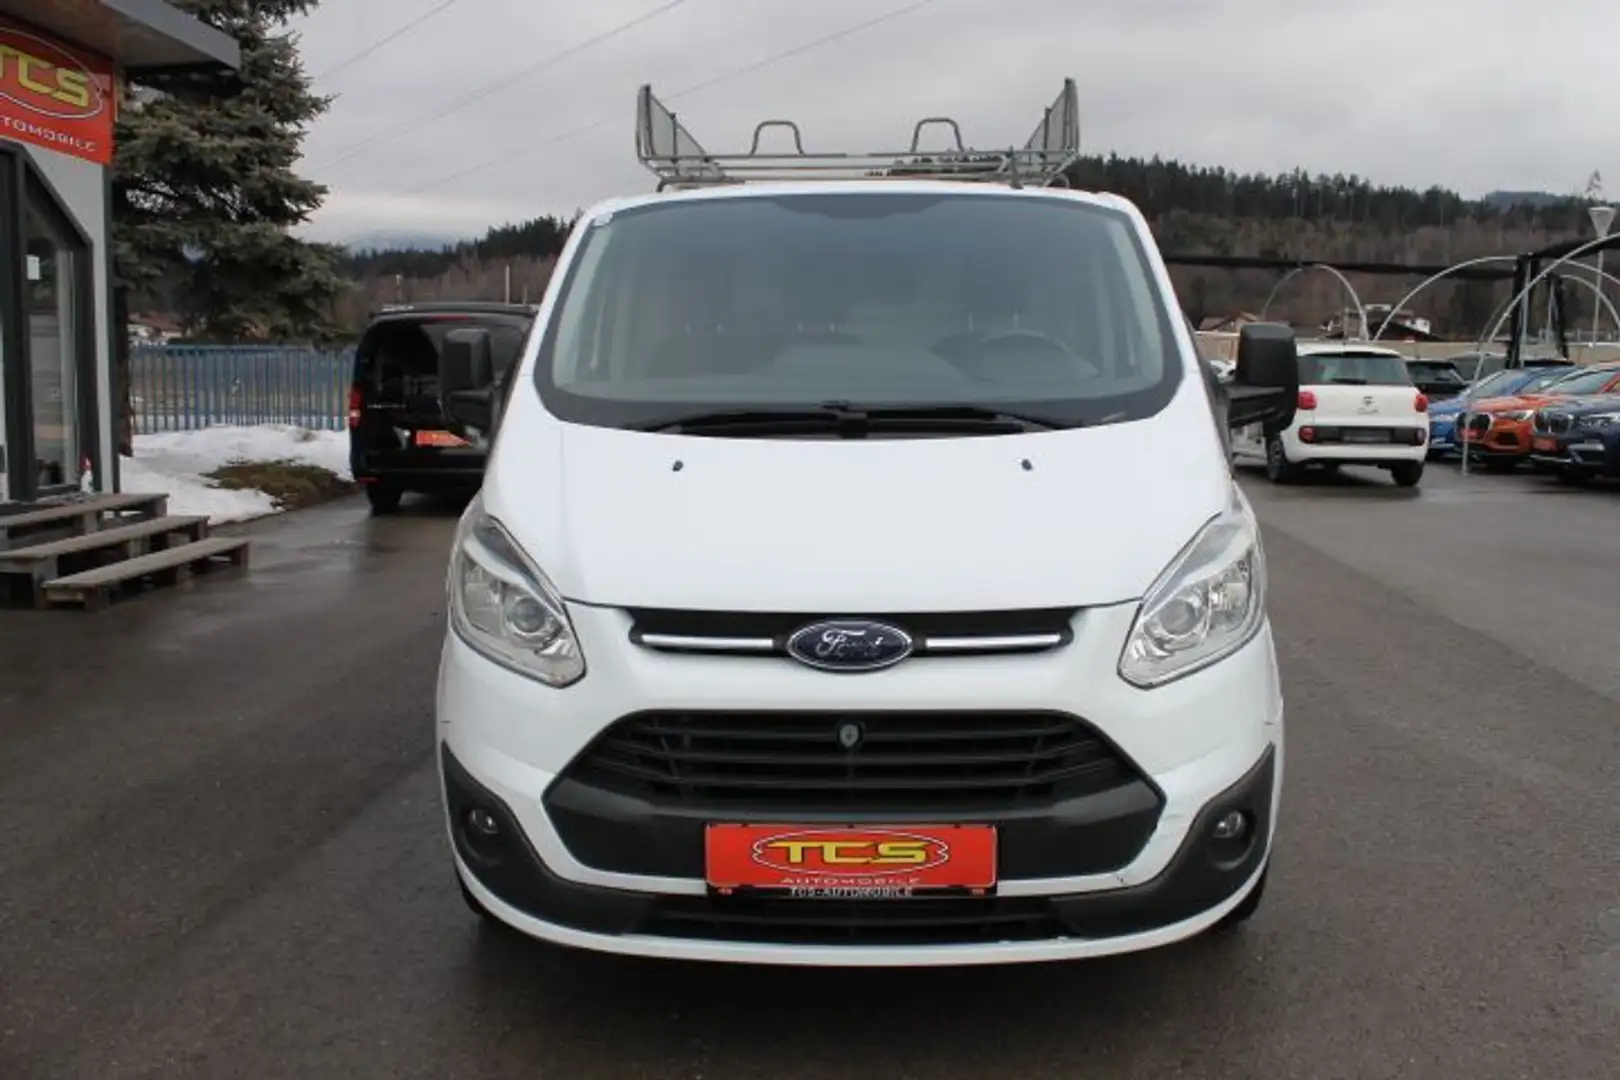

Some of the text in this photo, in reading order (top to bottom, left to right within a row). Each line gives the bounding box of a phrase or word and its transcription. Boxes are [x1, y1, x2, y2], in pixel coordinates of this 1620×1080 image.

[815, 629, 884, 657] Ford
[768, 840, 934, 865] TCS
[780, 876, 921, 886] AUTOMOBILE
